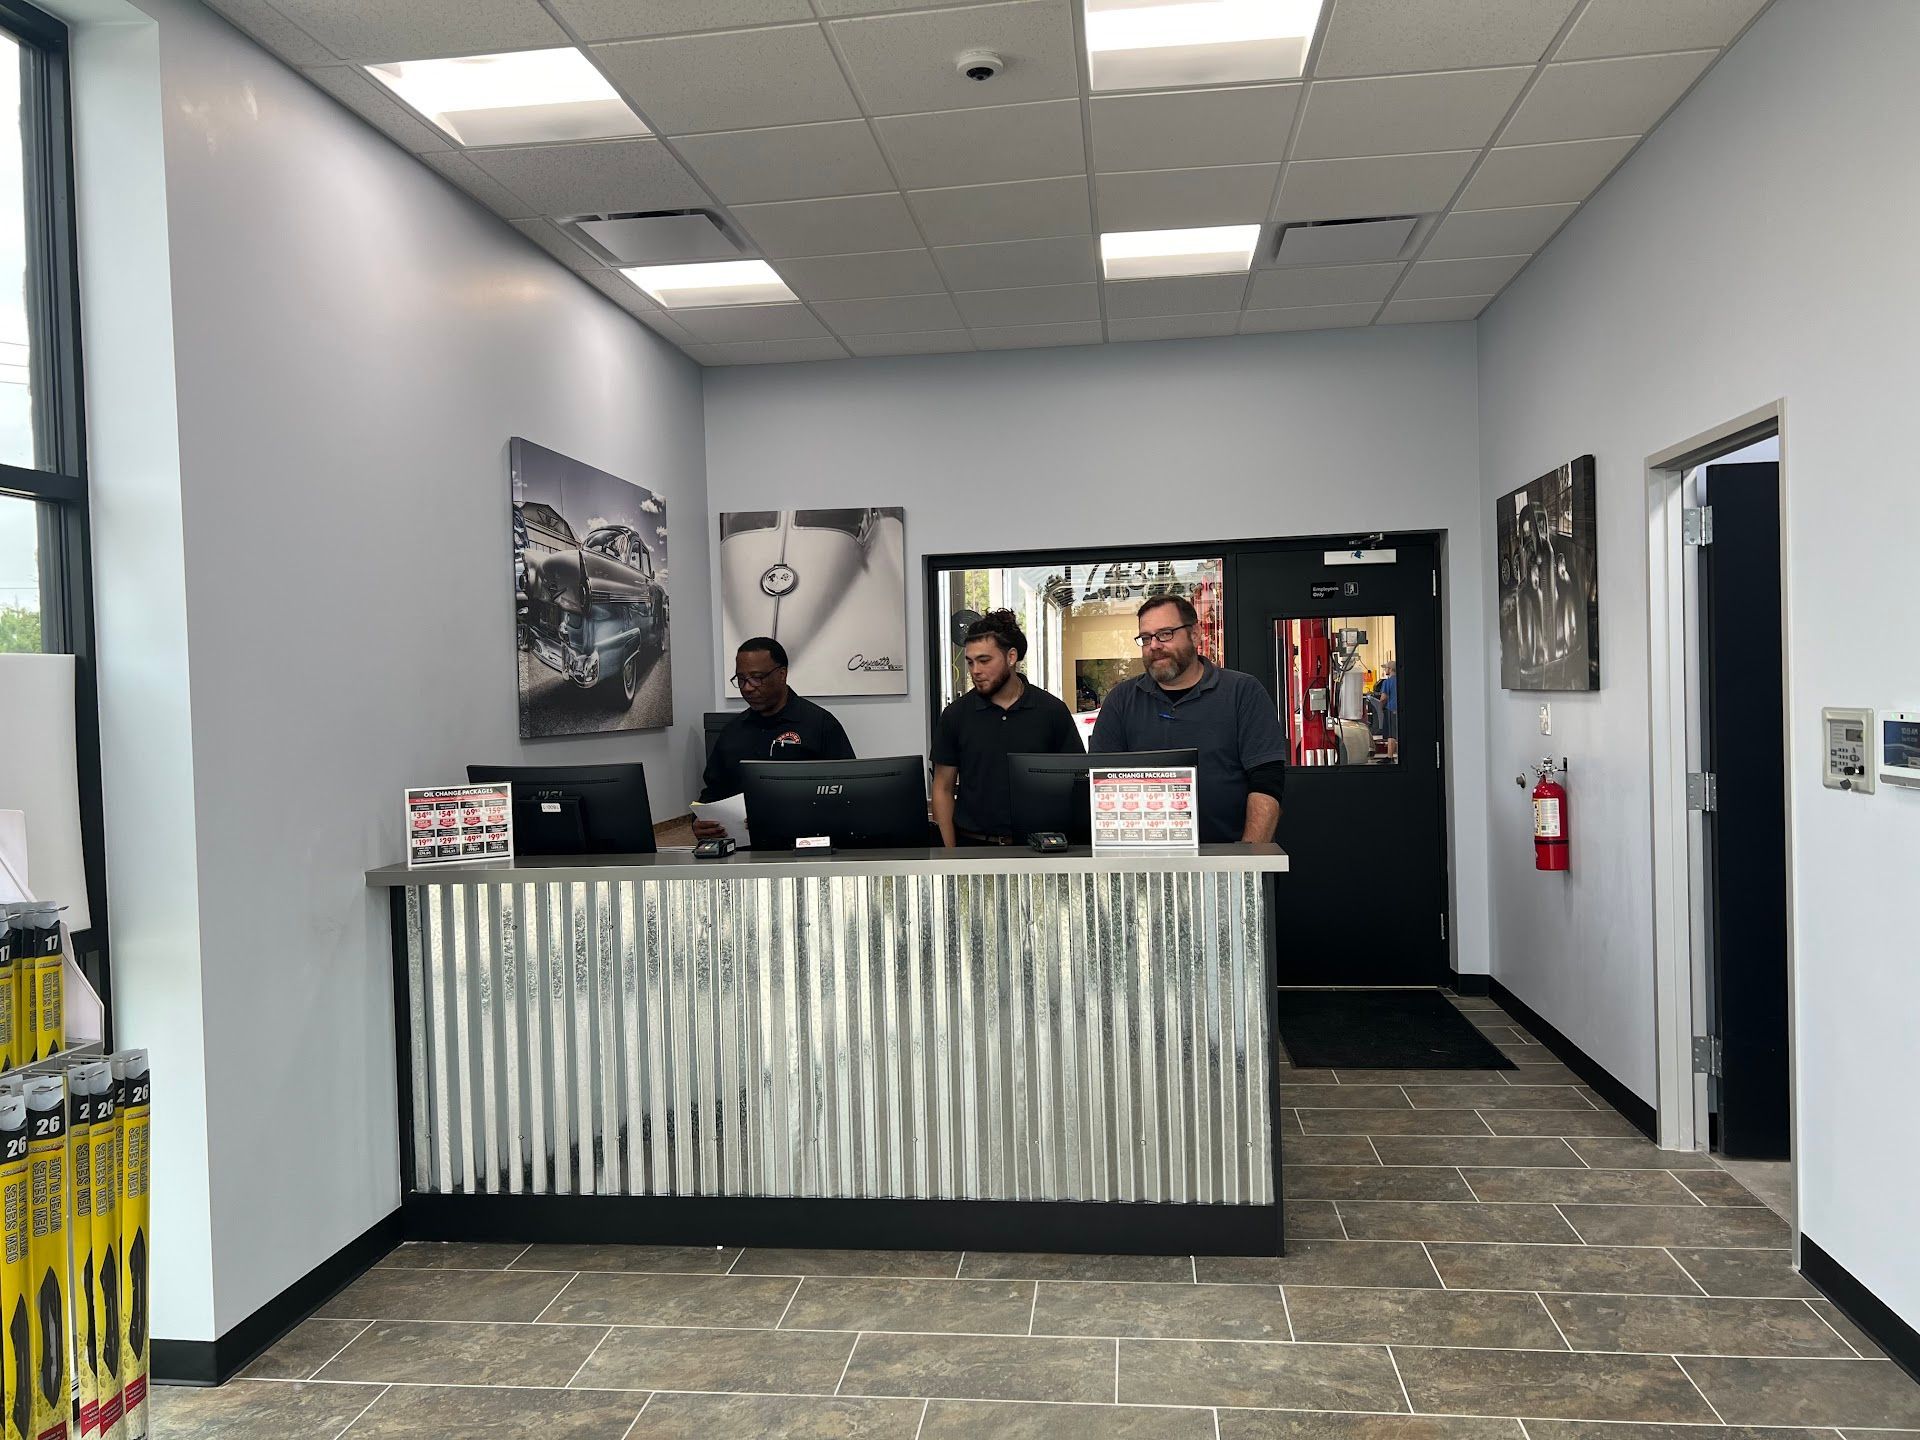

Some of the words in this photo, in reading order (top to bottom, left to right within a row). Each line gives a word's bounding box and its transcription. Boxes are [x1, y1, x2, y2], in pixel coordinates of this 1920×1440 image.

[435, 789, 461, 797] CHANGE
[462, 787, 493, 796] PACKAGES
[0, 945, 10, 961] 17
[45, 935, 58, 951] 17
[43, 972, 52, 1008] SERIES
[43, 1008, 53, 1032] OEM
[117, 1087, 125, 1104] 2
[133, 1083, 149, 1103] 26
[79, 1102, 89, 1120] 2
[97, 1098, 114, 1120] 26
[36, 1115, 60, 1137] 26
[6, 1135, 27, 1159] 26
[128, 1126, 140, 1169] SERIES
[50, 1155, 62, 1194] BLADE
[76, 1142, 90, 1187] SERIES
[95, 1142, 107, 1187] SERIES
[32, 1160, 47, 1206] SERIES
[128, 1170, 140, 1199] OEM
[4, 1183, 17, 1232] SERIES
[19, 1180, 28, 1217] BLADE
[77, 1188, 91, 1217] OEM
[96, 1187, 107, 1217] OEM
[32, 1207, 48, 1238] OEM
[50, 1194, 62, 1235] WIPER
[6, 1232, 19, 1265] OEM
[19, 1217, 29, 1261] WIPER
